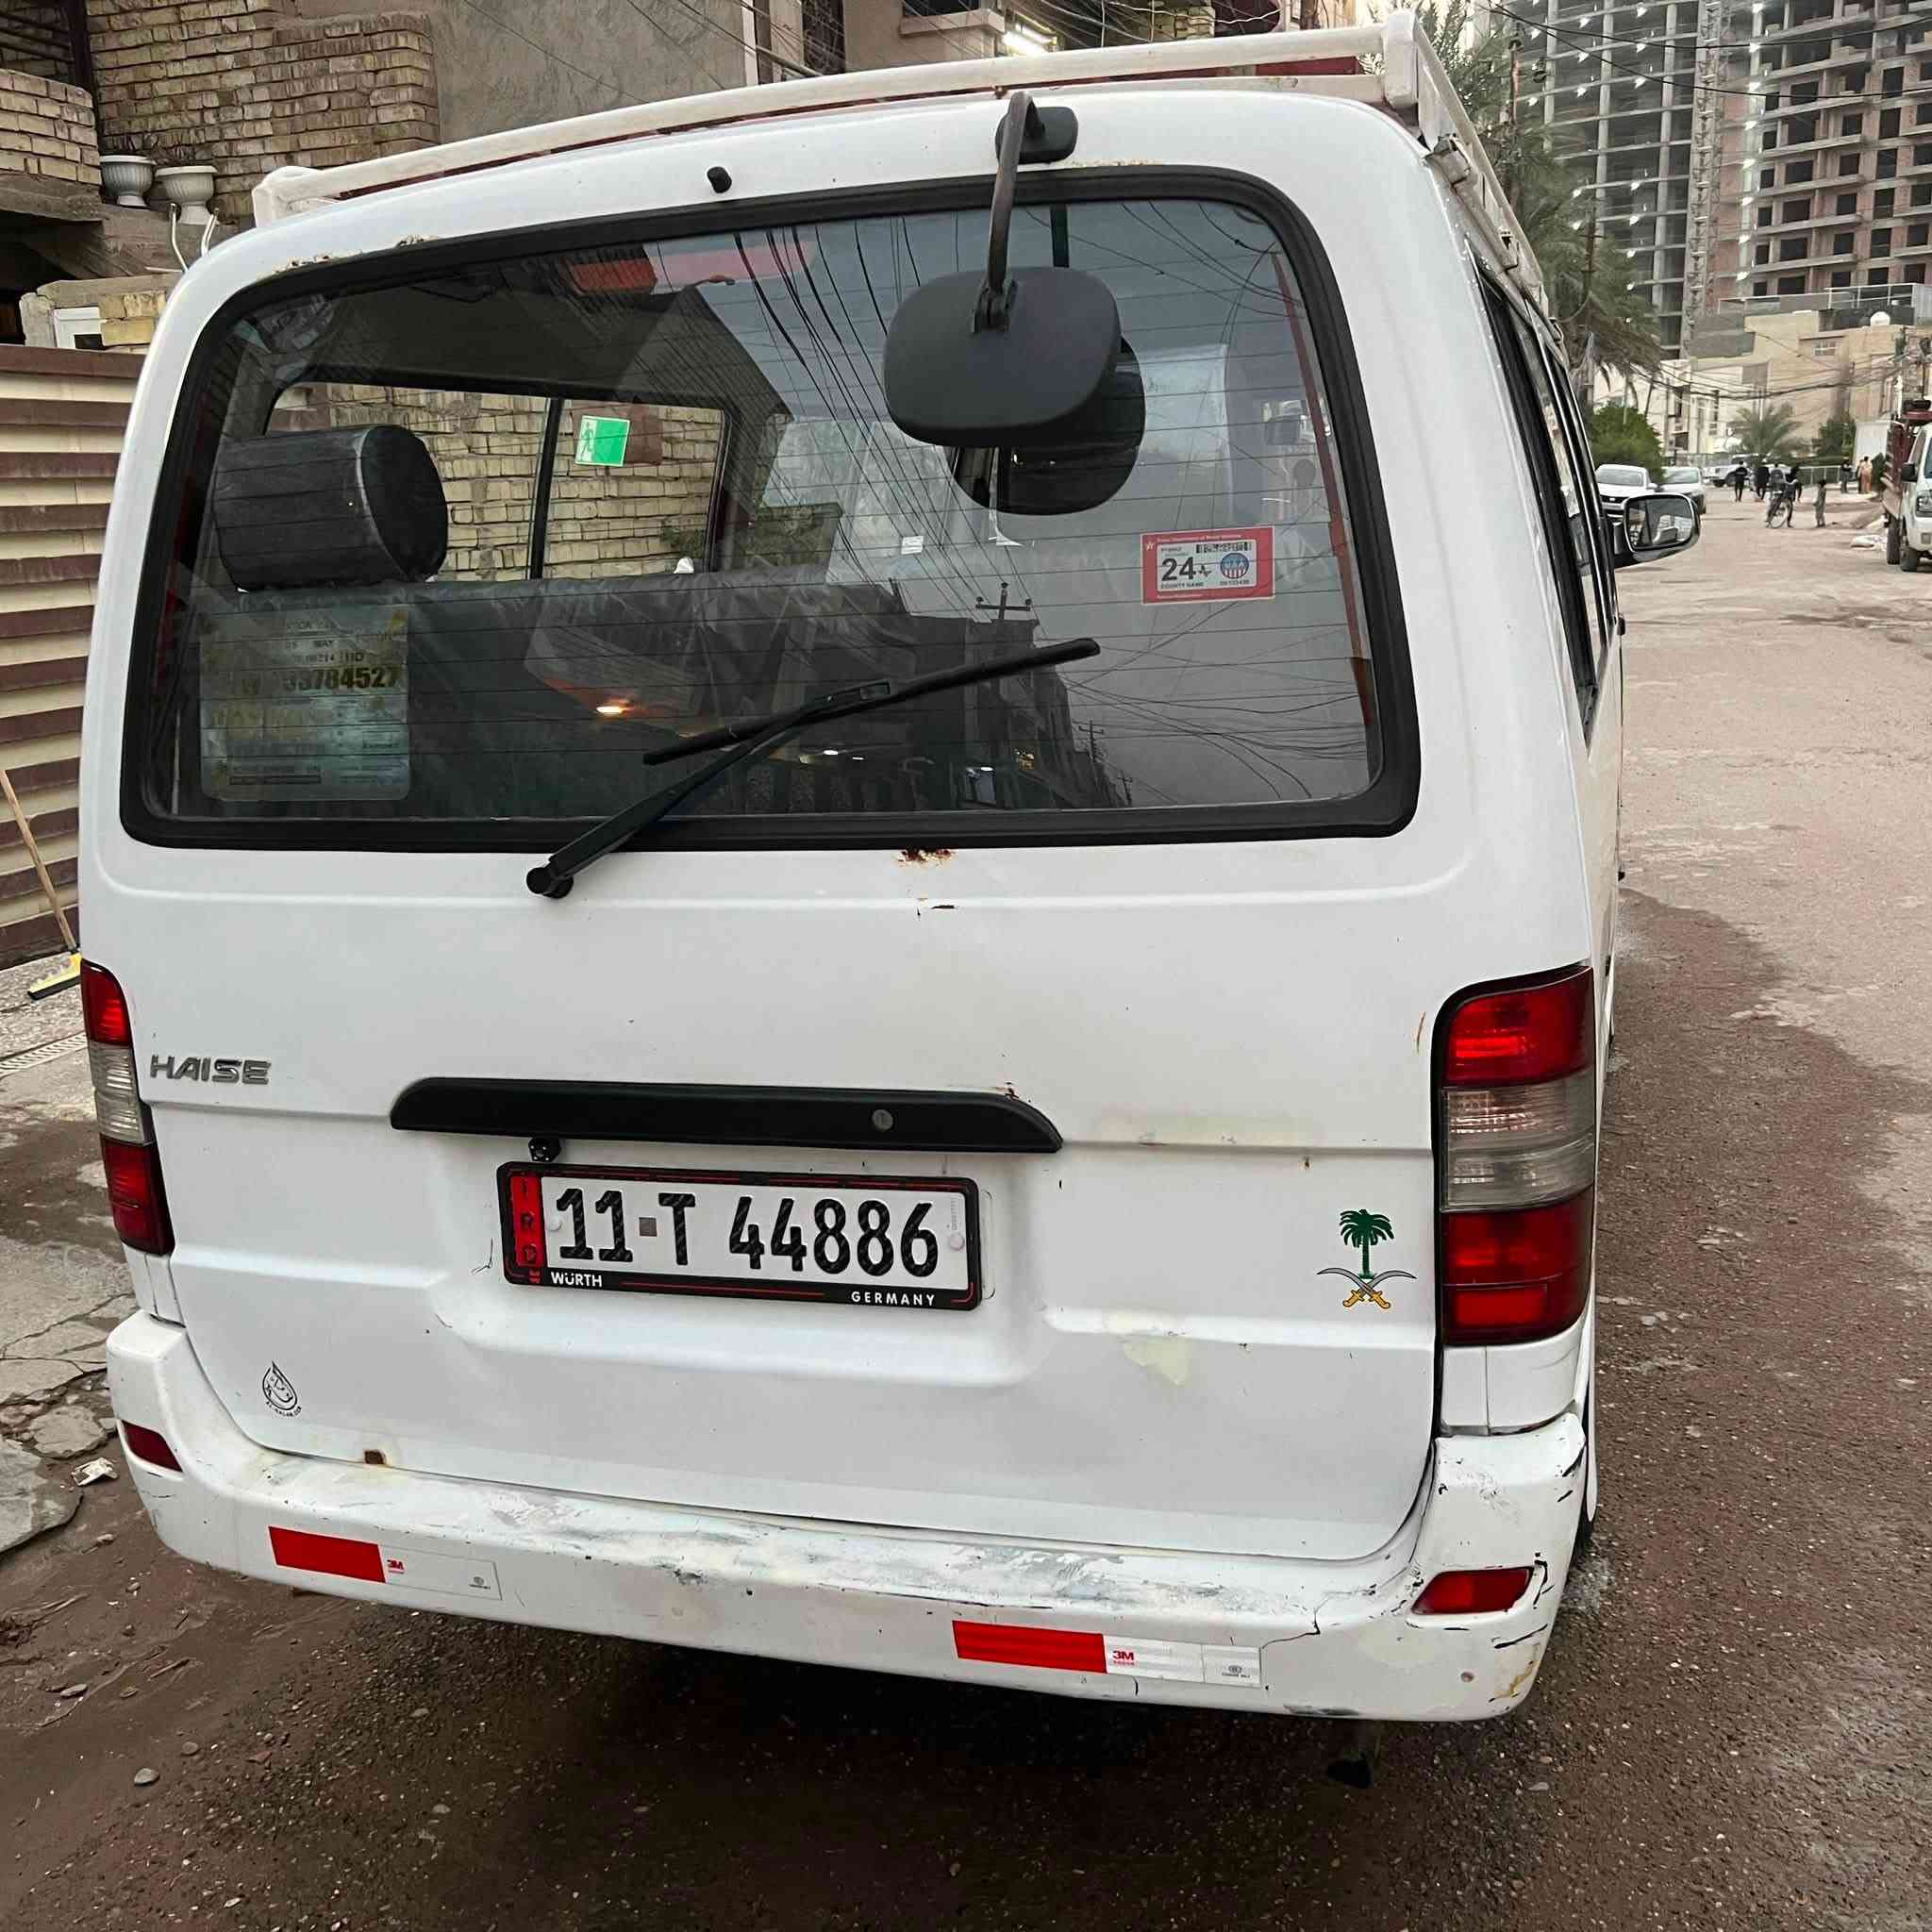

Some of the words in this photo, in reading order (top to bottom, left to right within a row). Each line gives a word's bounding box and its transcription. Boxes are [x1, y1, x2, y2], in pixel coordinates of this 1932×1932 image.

[1160, 557, 1195, 582] 24
[150, 1055, 272, 1085] HAISE
[556, 1188, 633, 1262] 11
[658, 1191, 696, 1266] T
[729, 1196, 939, 1278] 44886
[851, 1291, 935, 1307] GERMANY
[1112, 1650, 1135, 1661] 3M
